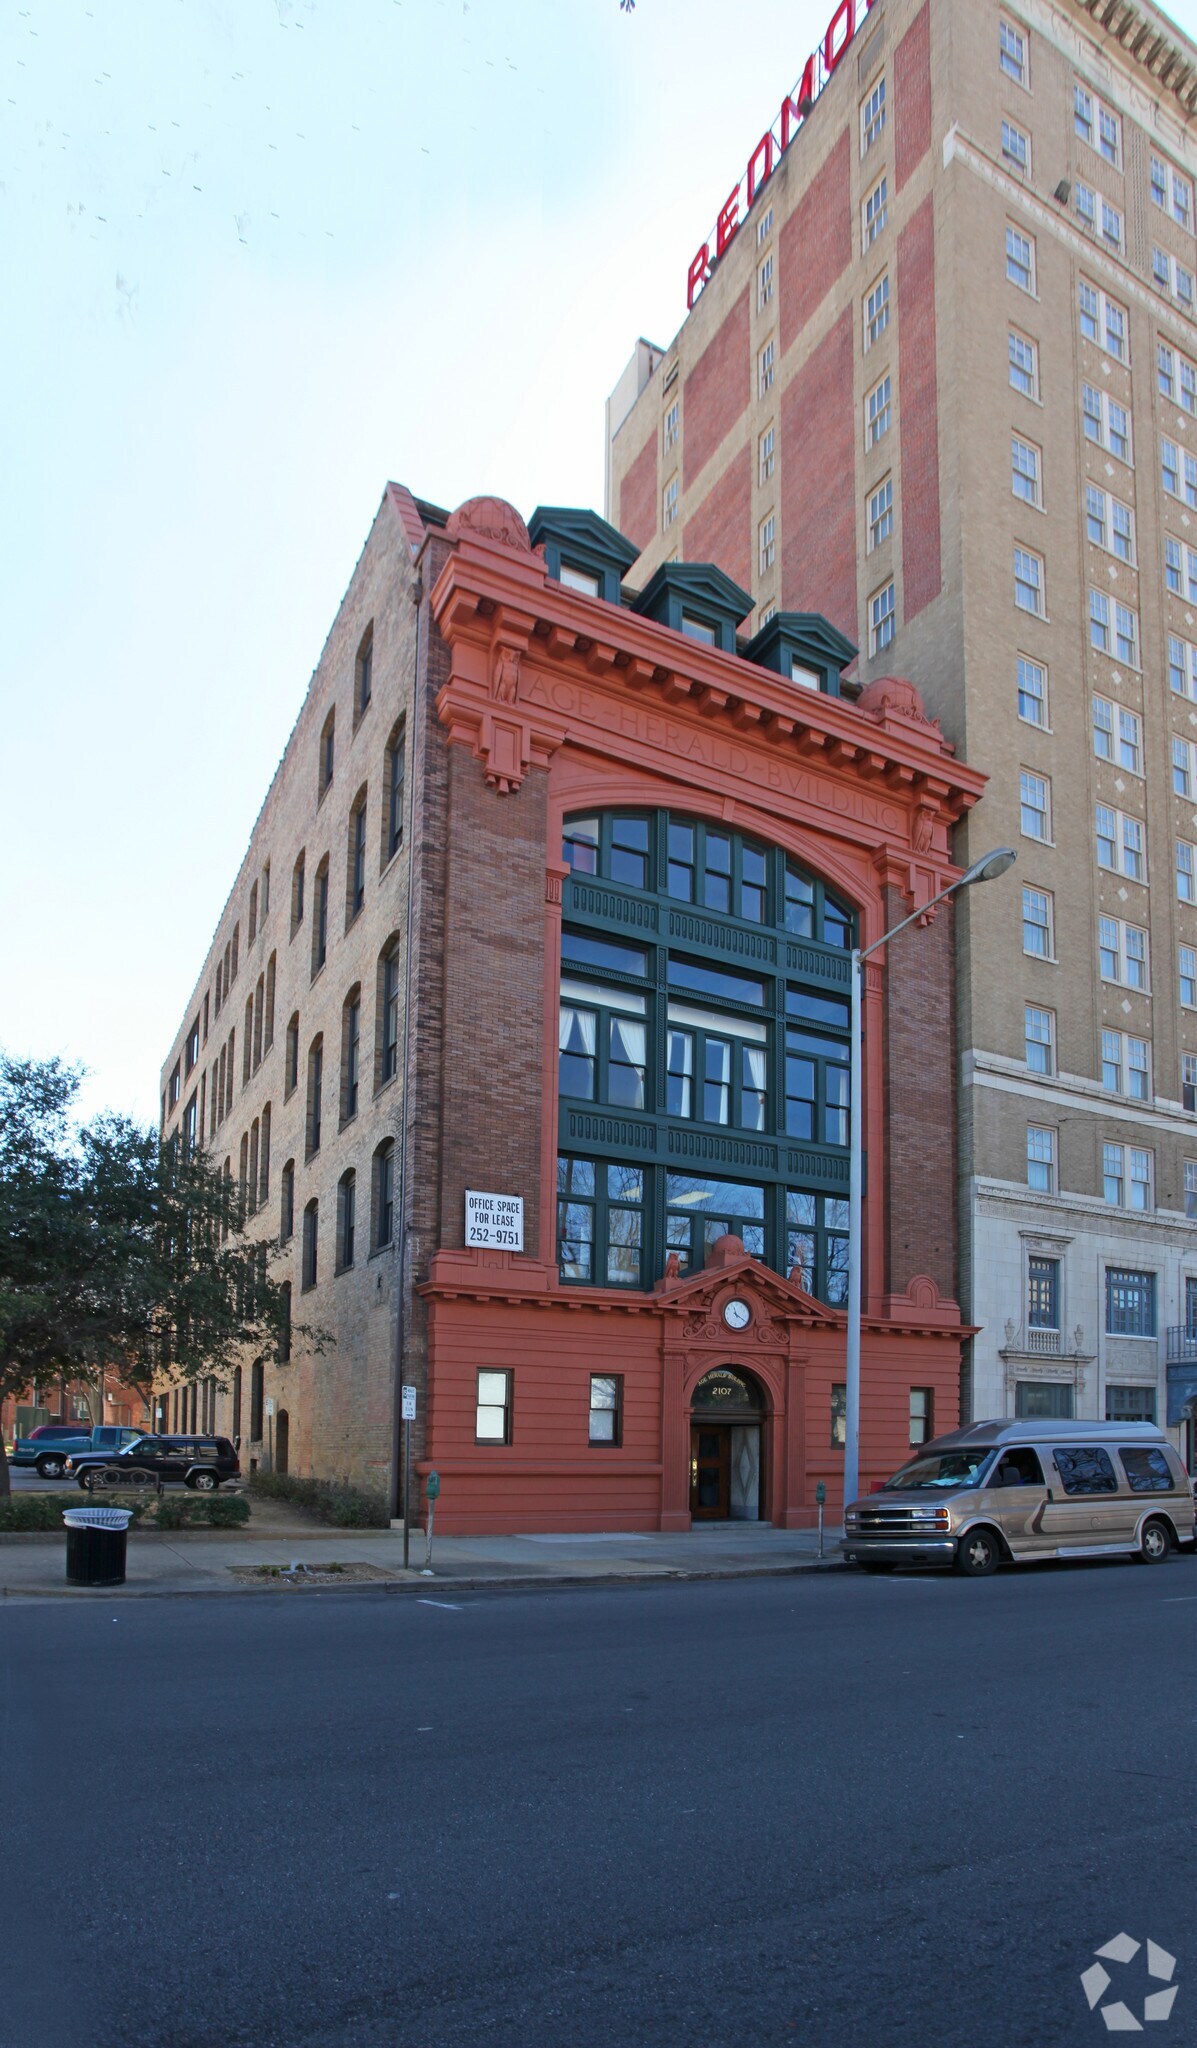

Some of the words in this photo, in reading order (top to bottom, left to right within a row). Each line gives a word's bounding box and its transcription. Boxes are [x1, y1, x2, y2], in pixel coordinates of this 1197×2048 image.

[687, 0, 874, 310] REDMO
[469, 1197, 494, 1210] OFFICE
[497, 1200, 520, 1213] SPACE
[475, 1212, 489, 1224] FOR
[492, 1214, 514, 1227] LEASE
[470, 1227, 520, 1245] 252-9751
[712, 1387, 732, 1395] 2107
